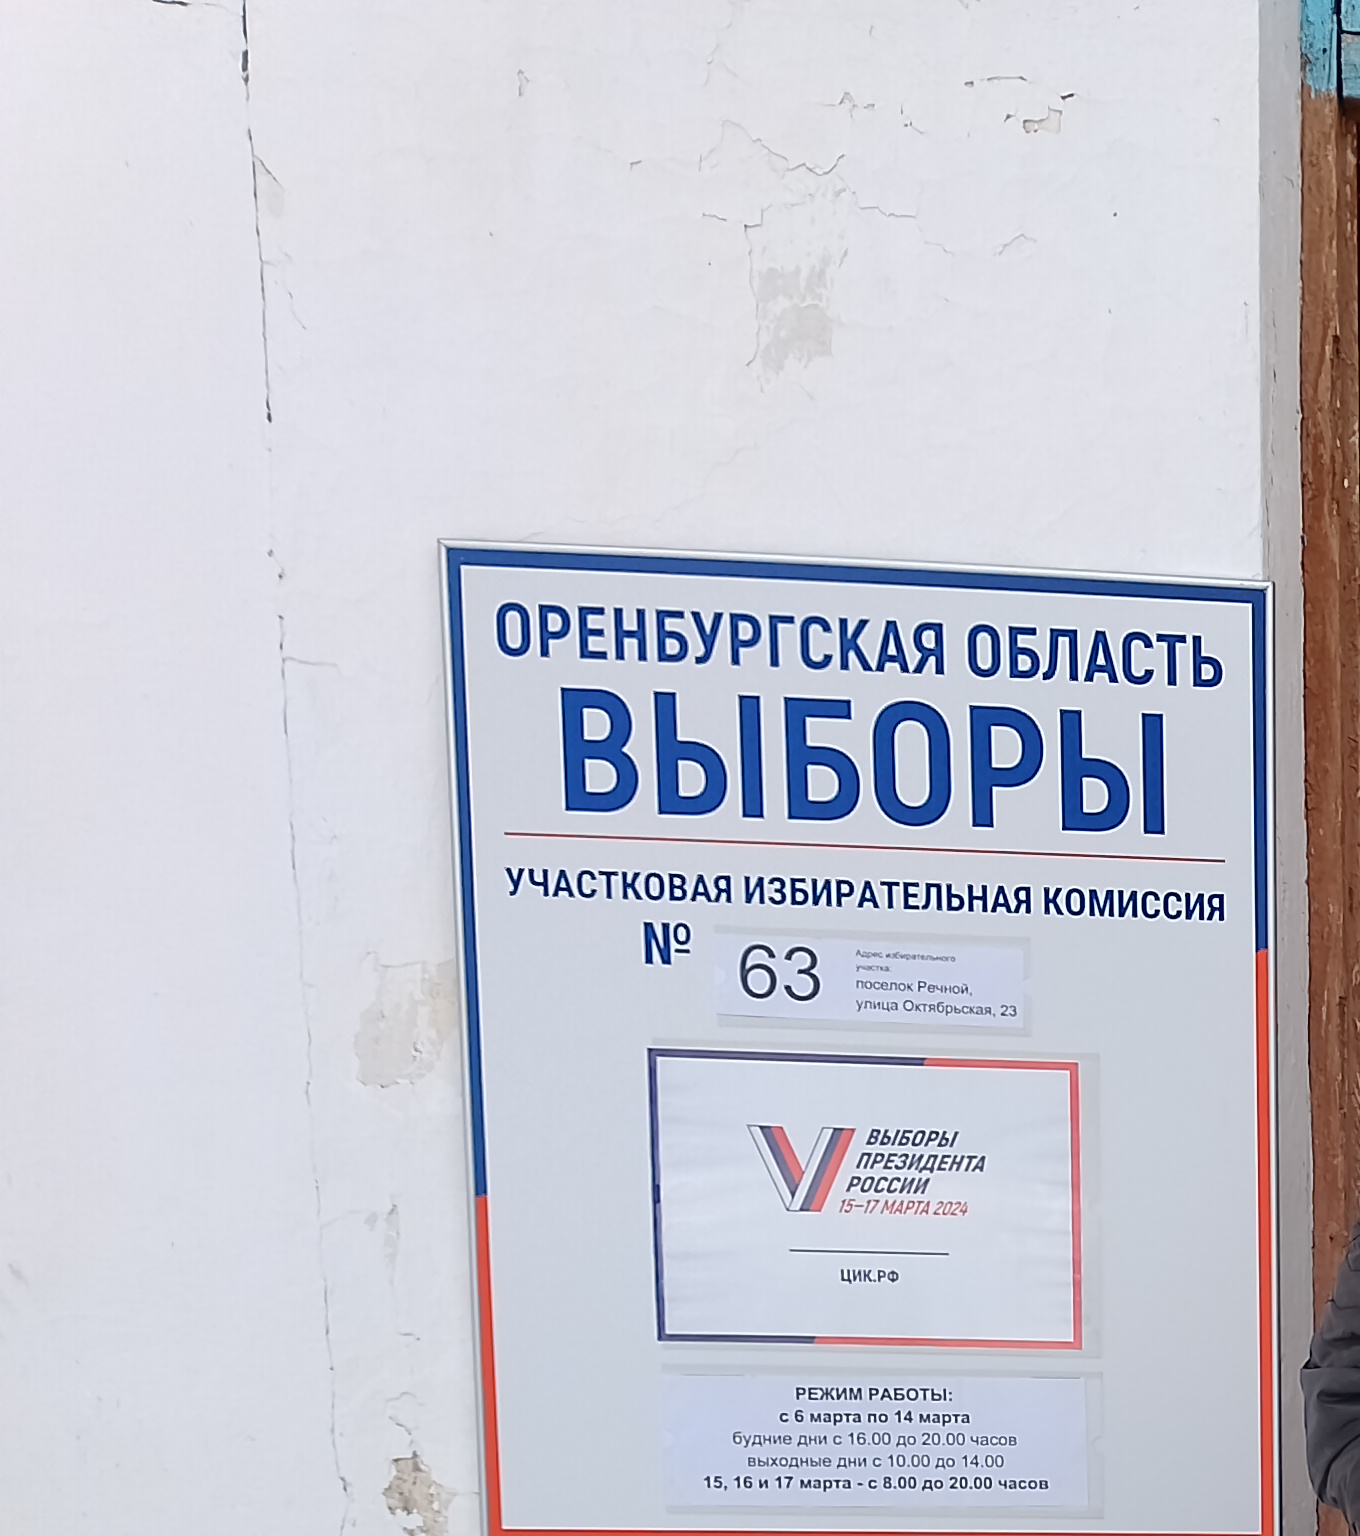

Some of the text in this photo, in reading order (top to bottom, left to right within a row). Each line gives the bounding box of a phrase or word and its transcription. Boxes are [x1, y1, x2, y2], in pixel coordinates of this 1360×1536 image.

[495, 601, 1225, 689] ОРЕНБУРГСКАЯ ОБЛАСТЬ
[560, 686, 1167, 836] ВЫБОРЫ
[504, 867, 1226, 923] УЧАСТКОВАЯ ИЗБИРАТЕЛЬНАЯ КОМИССИЯ
[643, 921, 821, 1002] № 63
[856, 979, 973, 997] поселок Речной,
[856, 999, 1018, 1018] улица Октябрьская, 23
[865, 1128, 960, 1149] ВЫБОРЫ
[856, 1152, 987, 1174] ПРЕЗИДЕНТА
[845, 1175, 931, 1195] РОССИИ
[881, 1199, 930, 1216] МАРТА
[933, 1201, 969, 1217] 2024
[839, 1268, 900, 1285] ЦИК.РФ
[795, 1386, 953, 1402] РЕЖИМ РАБОТЫ:
[779, 1409, 971, 1428] с 6 марта по 14 марта
[732, 1431, 1018, 1449] будние дни с 16.00 до 20.00 часов
[747, 1454, 1005, 1471] выходные дни с 10.00 до 14.00
[703, 1476, 729, 1492] 15,
[733, 1476, 753, 1490] 16
[758, 1478, 769, 1490] и
[774, 1476, 794, 1490] 17
[799, 1478, 852, 1493] марта
[868, 1478, 878, 1491] с
[883, 1476, 917, 1491] 8.00
[921, 1478, 944, 1493] до
[949, 1476, 993, 1491] 20.00
[998, 1478, 1050, 1491] часов
